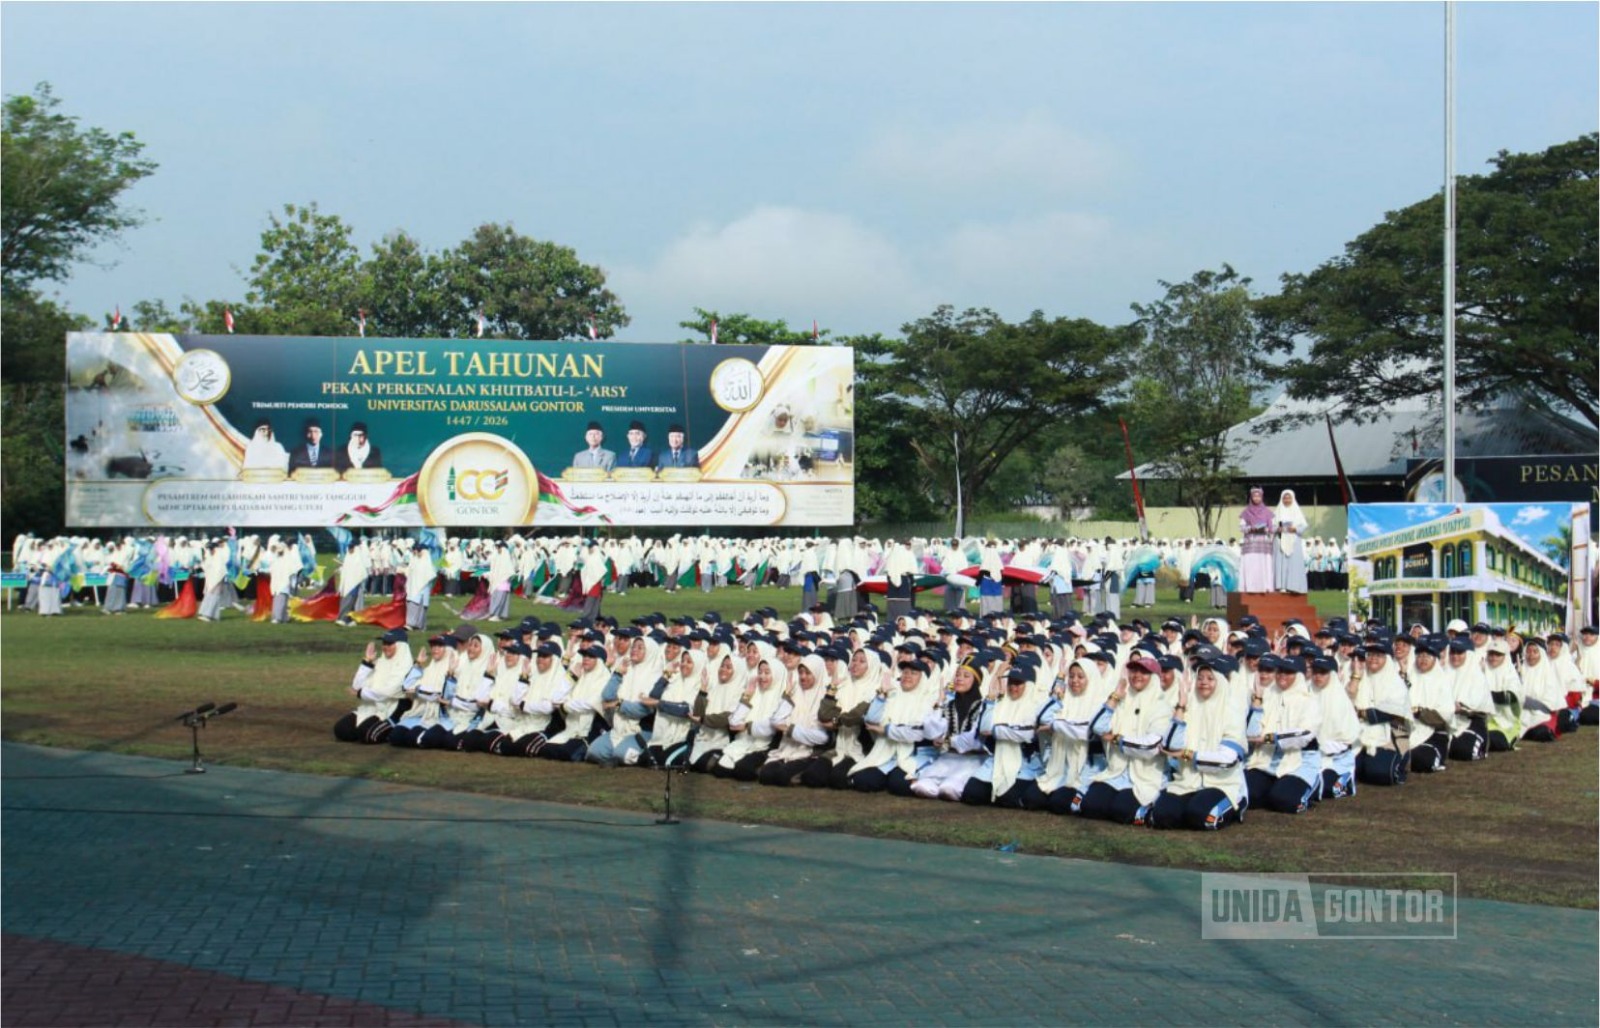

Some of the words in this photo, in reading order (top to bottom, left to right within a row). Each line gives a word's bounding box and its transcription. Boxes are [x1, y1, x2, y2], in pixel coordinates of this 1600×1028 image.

[348, 349, 436, 375] APEL
[443, 351, 605, 378] TAHUNAN
[322, 381, 373, 395] PEKAN
[377, 382, 476, 396] PERKENALAN
[367, 399, 447, 411] UNIVERSITAS
[450, 400, 527, 412] DARUSSALAM
[529, 401, 585, 413] GONTOR
[446, 415, 471, 426] 1447
[474, 415, 480, 426] /
[482, 415, 508, 426] 2026
[456, 506, 499, 515] GONTOR
